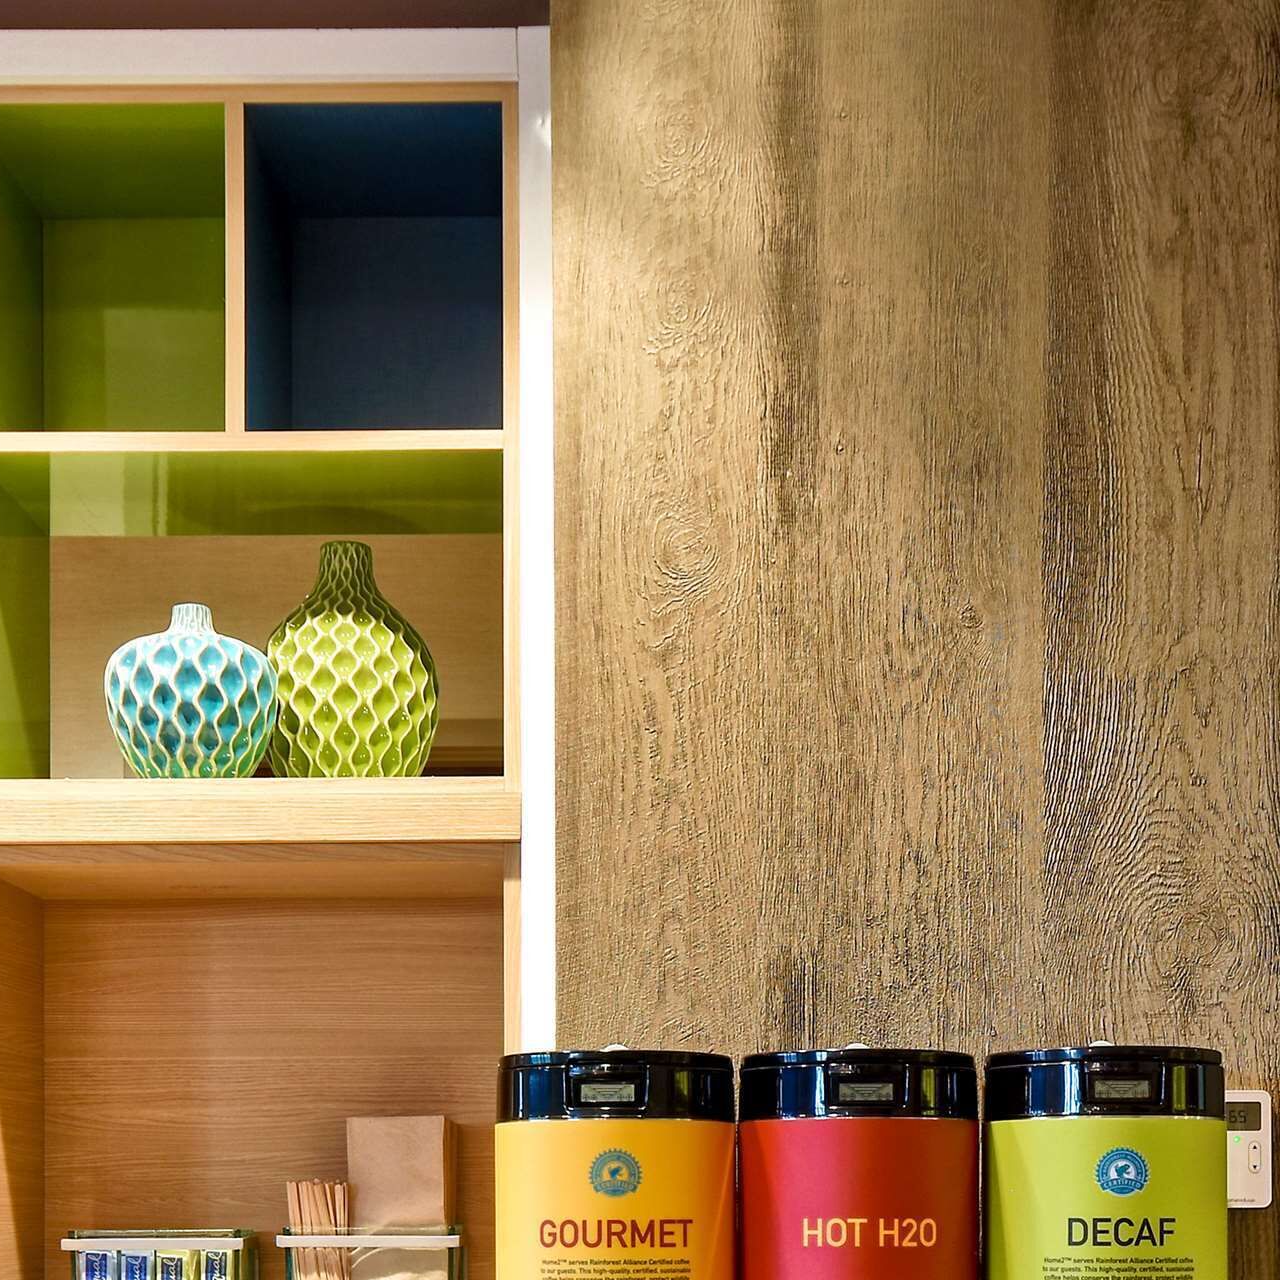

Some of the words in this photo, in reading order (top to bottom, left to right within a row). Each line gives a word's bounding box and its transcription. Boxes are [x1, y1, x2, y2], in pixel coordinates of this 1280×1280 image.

[539, 1219, 693, 1248] GOURMET
[802, 1218, 868, 1248] HOT
[1067, 1218, 1176, 1247] DECAF
